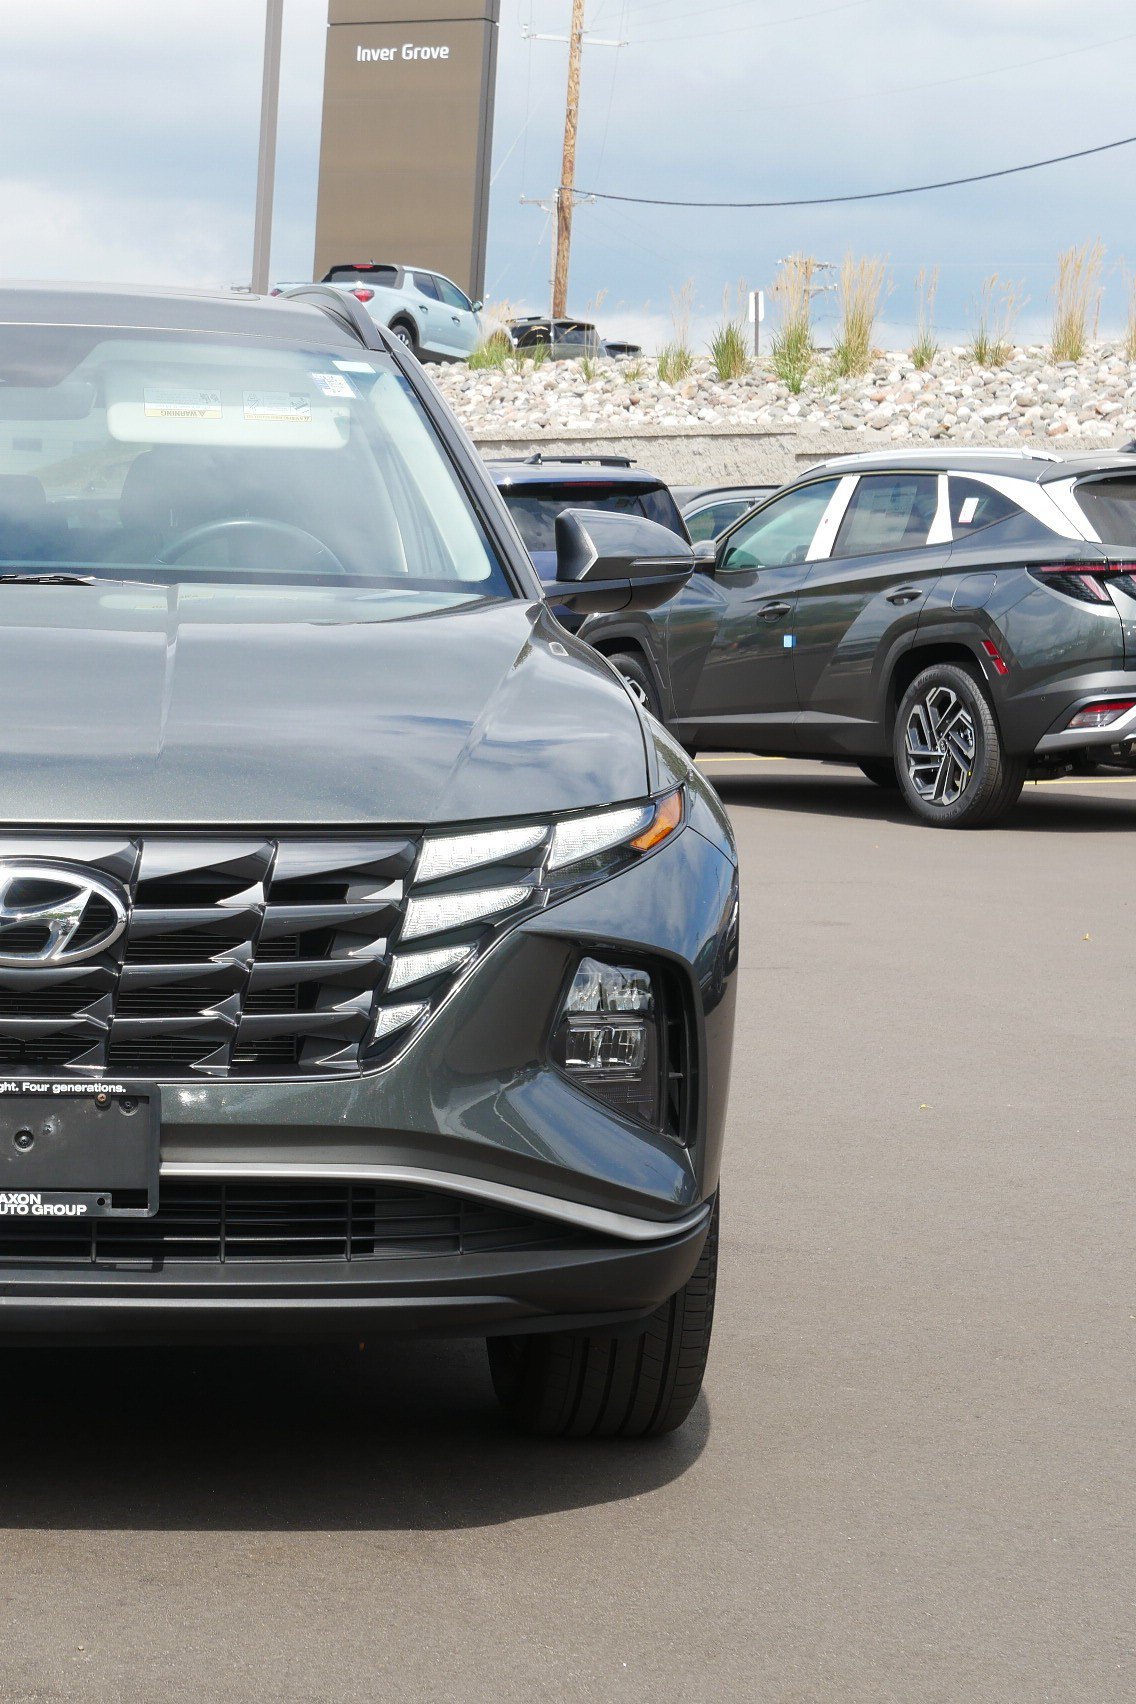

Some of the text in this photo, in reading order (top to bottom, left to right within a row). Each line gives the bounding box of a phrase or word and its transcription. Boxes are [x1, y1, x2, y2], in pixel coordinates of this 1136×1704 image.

[356, 43, 450, 62] Inver Grove
[22, 1081, 50, 1092] Four
[52, 1082, 127, 1094] generations.
[31, 1204, 88, 1216] GROUP
